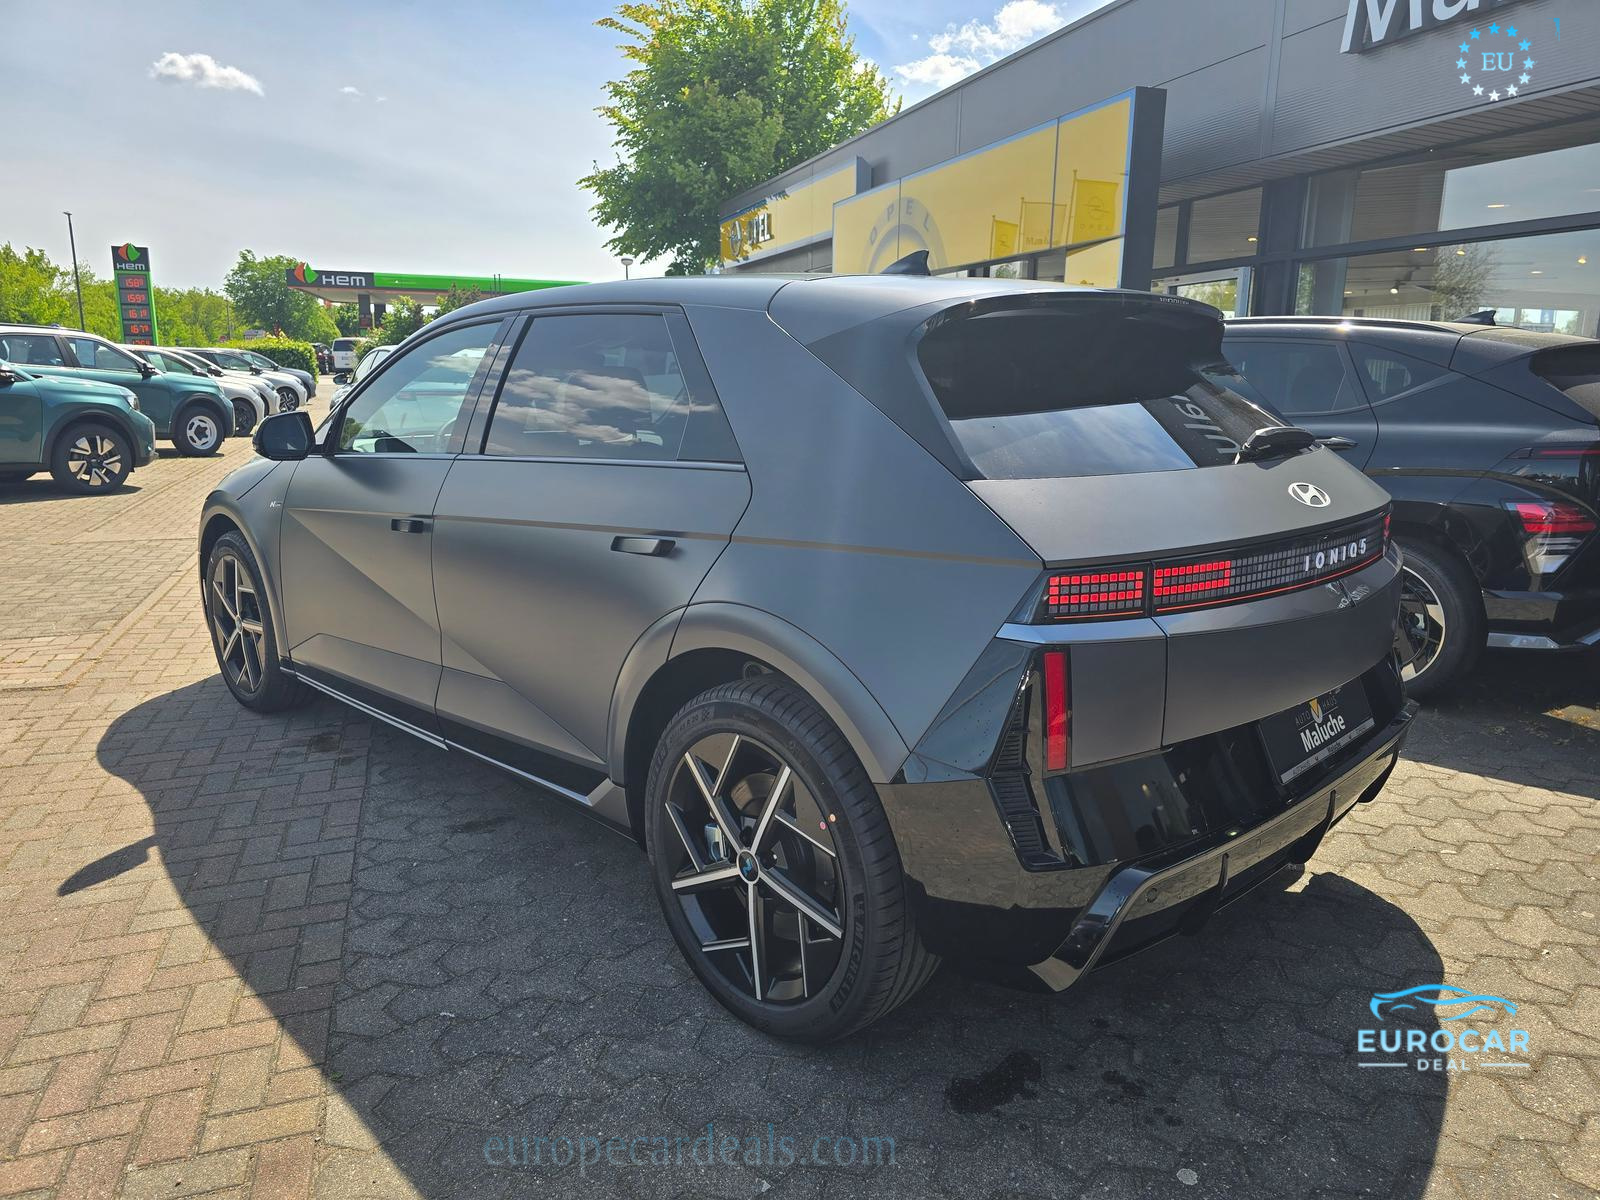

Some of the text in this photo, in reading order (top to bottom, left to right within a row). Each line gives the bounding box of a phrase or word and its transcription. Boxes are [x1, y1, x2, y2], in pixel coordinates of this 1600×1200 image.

[870, 199, 931, 246] OPEL
[1299, 713, 1347, 753] Maluche
[832, 920, 865, 1011] MICHELIN
